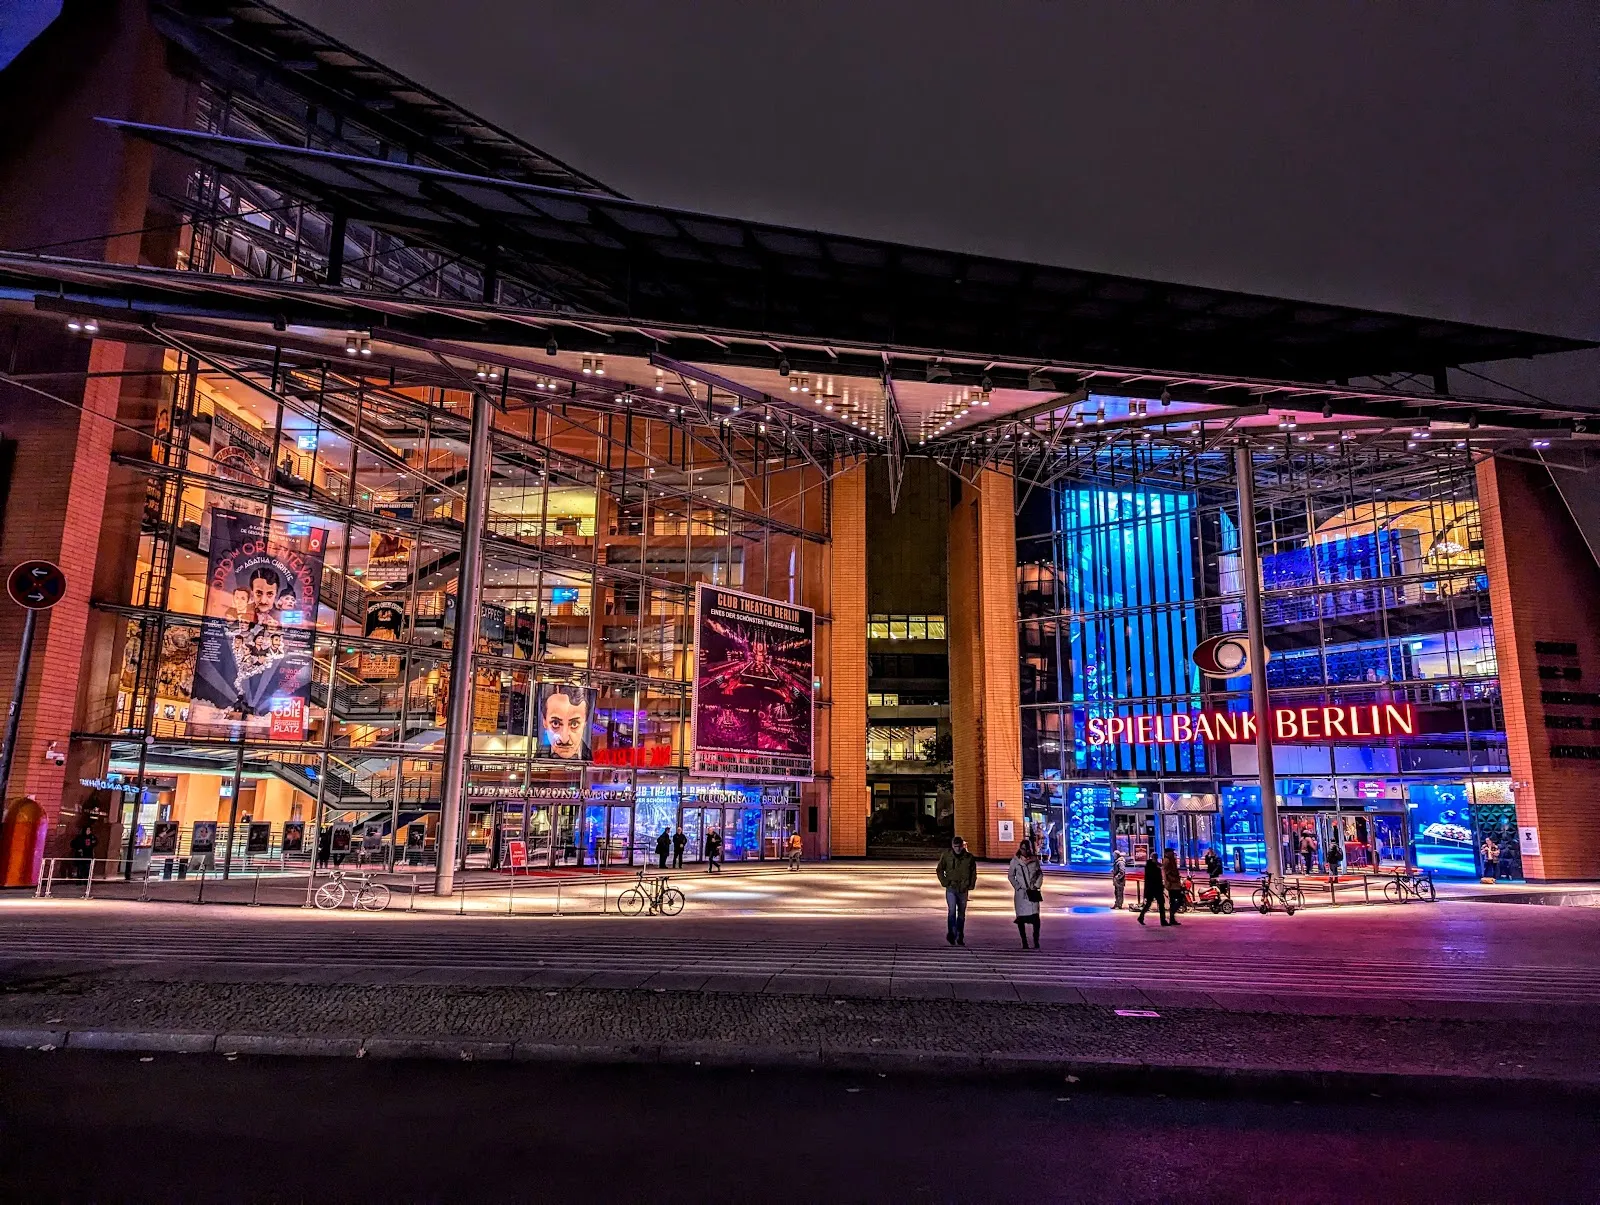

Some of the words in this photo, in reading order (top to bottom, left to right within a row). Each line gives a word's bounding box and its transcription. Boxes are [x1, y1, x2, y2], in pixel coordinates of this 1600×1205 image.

[244, 557, 270, 568] AGATHA
[271, 559, 294, 581] CHRISTIE
[718, 593, 737, 609] CLUB
[741, 598, 772, 617] THEATER
[775, 606, 799, 622] BERLIN
[711, 609, 725, 617] EINES
[726, 611, 736, 619] DER
[737, 614, 763, 625] SCHÖNSTEN
[764, 620, 784, 629] THEATER
[790, 625, 804, 633] BERLIN
[274, 725, 299, 733] PLATZ
[1088, 712, 1256, 745] SPIELBANK
[1276, 704, 1412, 738] BERLIN
[472, 785, 524, 798] THEATER
[526, 786, 544, 799] AM
[545, 787, 607, 800] POTSDAMER
[702, 794, 725, 804] CLUB
[727, 794, 760, 804] THEATER
[762, 795, 789, 805] BERLIN
